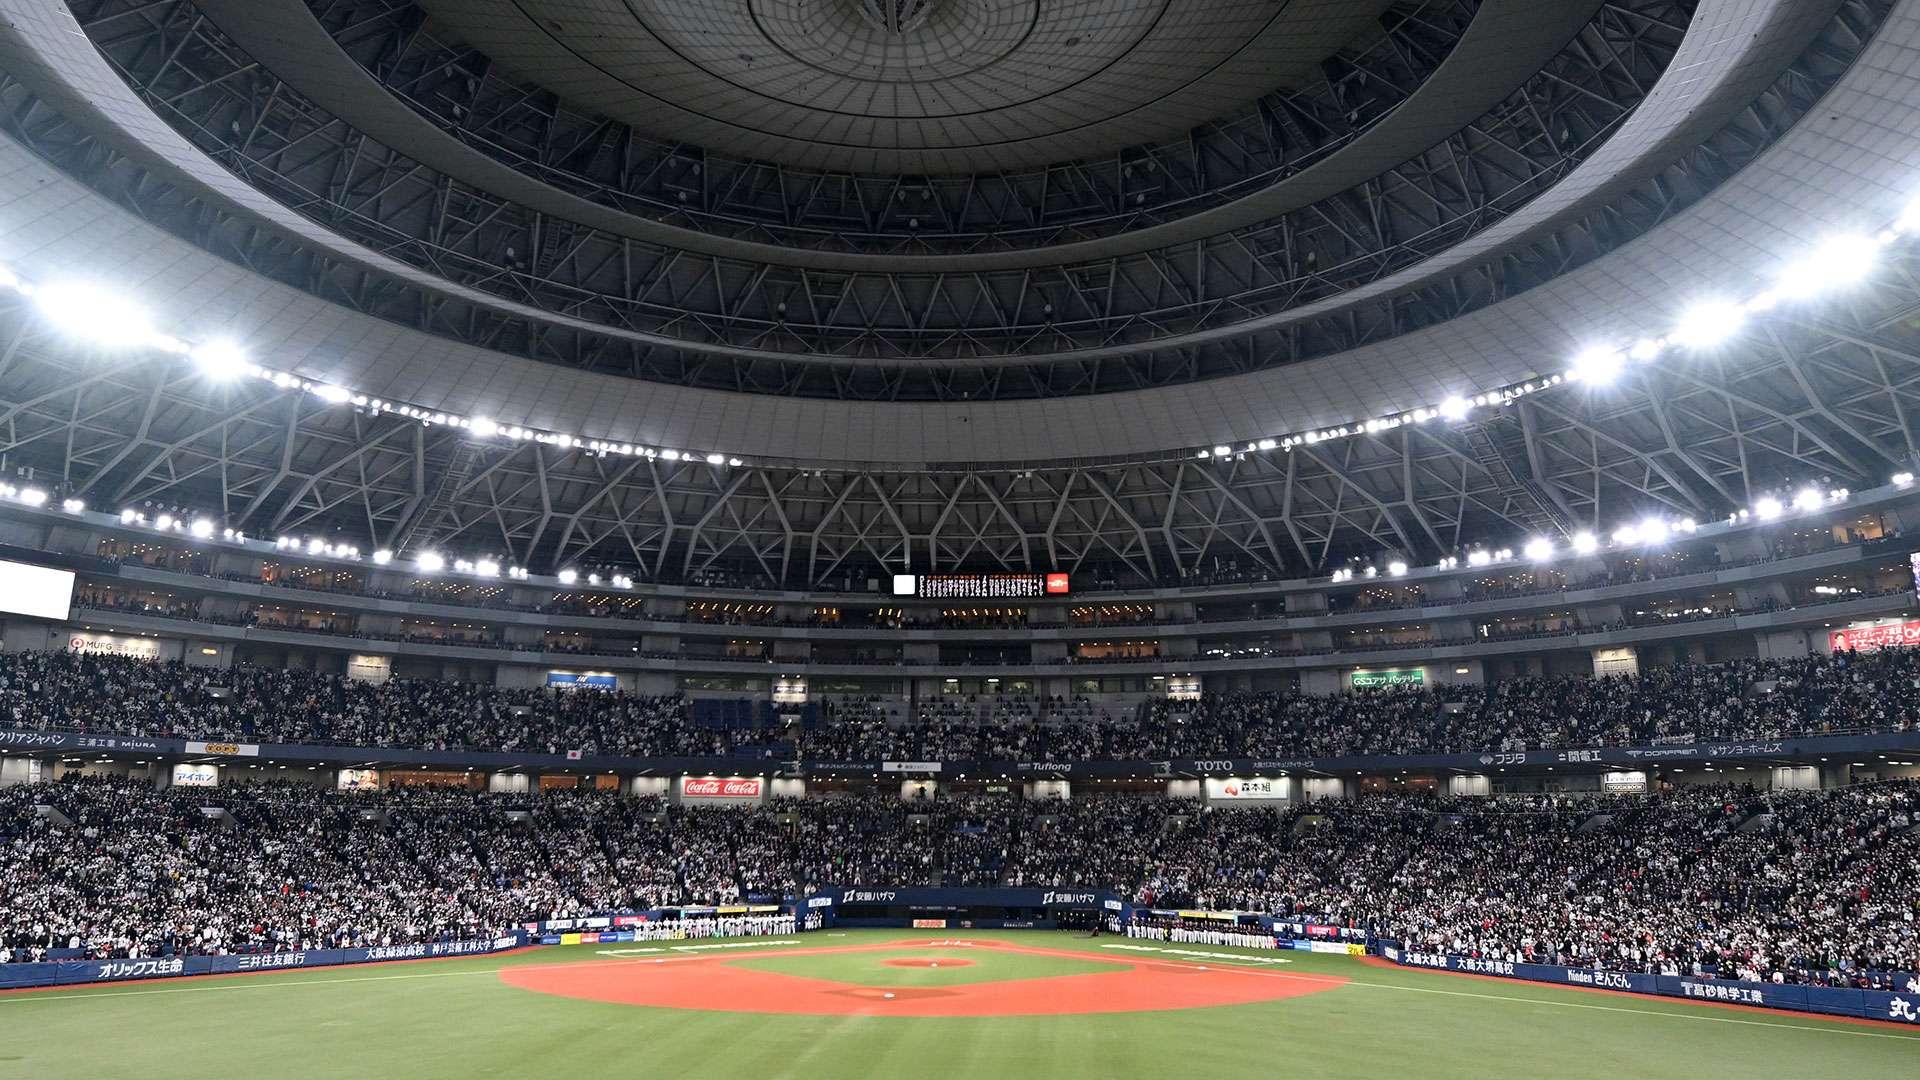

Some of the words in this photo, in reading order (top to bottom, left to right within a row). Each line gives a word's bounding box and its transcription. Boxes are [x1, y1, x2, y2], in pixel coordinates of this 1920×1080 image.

[86, 641, 112, 650] MUFG
[1354, 677, 1386, 685] GSユアサ
[1719, 743, 1782, 755] サンヨーホームズ
[1495, 753, 1525, 764] フジタ
[1568, 750, 1601, 762] 関電工
[1033, 762, 1072, 772] Tuflong
[1194, 761, 1233, 771] TOTO
[176, 773, 214, 781] アイホン
[432, 940, 491, 954] 神戸芸術工科大学
[238, 953, 305, 969] 三井住友銀行
[1405, 952, 1447, 967] 大商大高校
[98, 958, 184, 978] オリックス生命
[1457, 958, 1514, 975] 大商大堺高校
[1568, 969, 1592, 983] Kinden
[1594, 971, 1631, 988] きんでん
[1693, 983, 1763, 1003] 高砂熱学工業
[1889, 996, 1920, 1020] 丸
